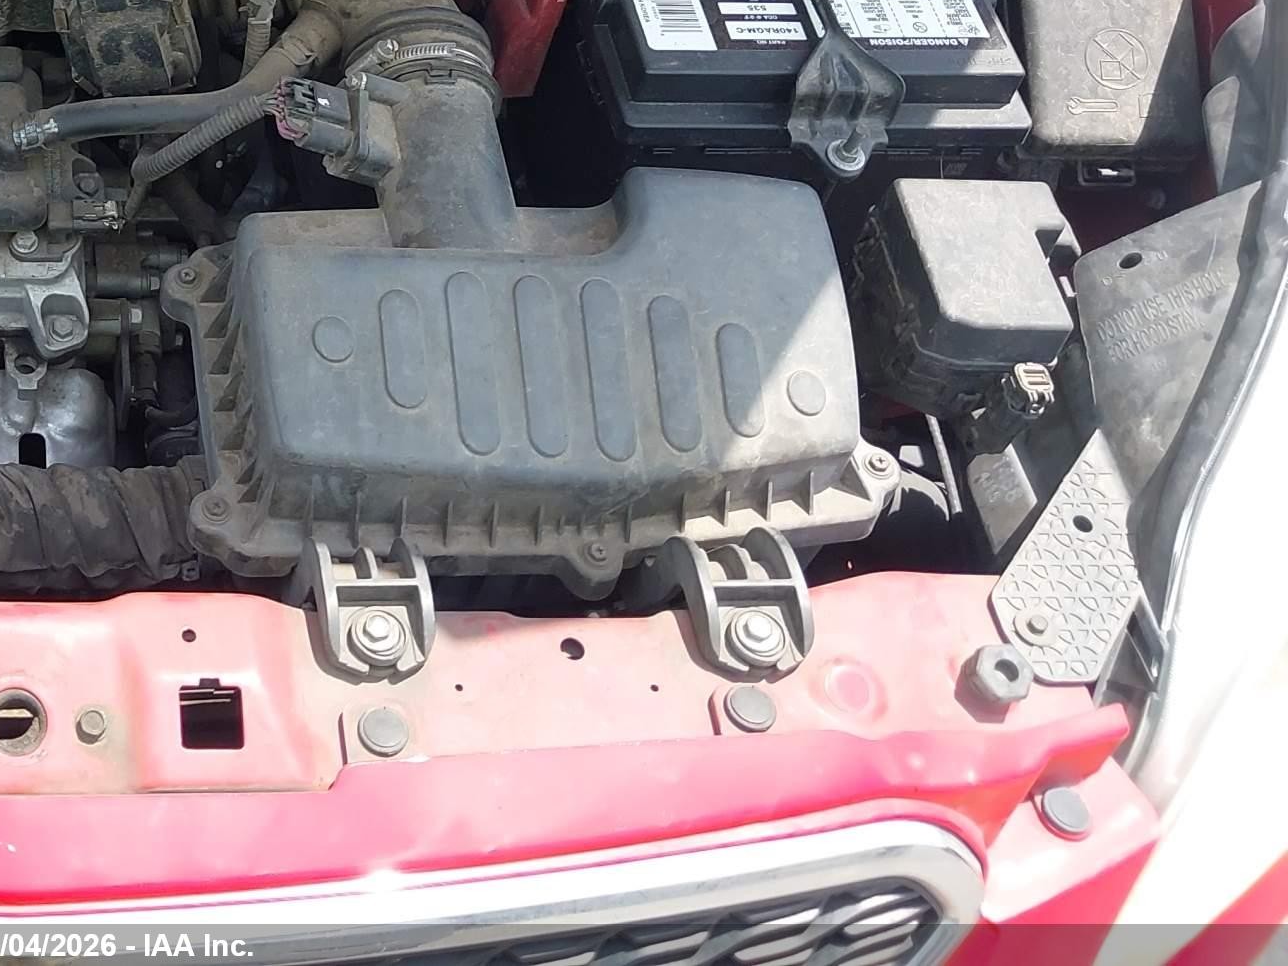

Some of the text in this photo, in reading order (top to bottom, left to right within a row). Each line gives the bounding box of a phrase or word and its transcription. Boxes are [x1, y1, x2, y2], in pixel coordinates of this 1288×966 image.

[639, 4, 651, 23] KOREA
[869, 38, 958, 46] DANGER/POISON
[1142, 295, 1168, 320] USE
[1167, 282, 1194, 310] THIS
